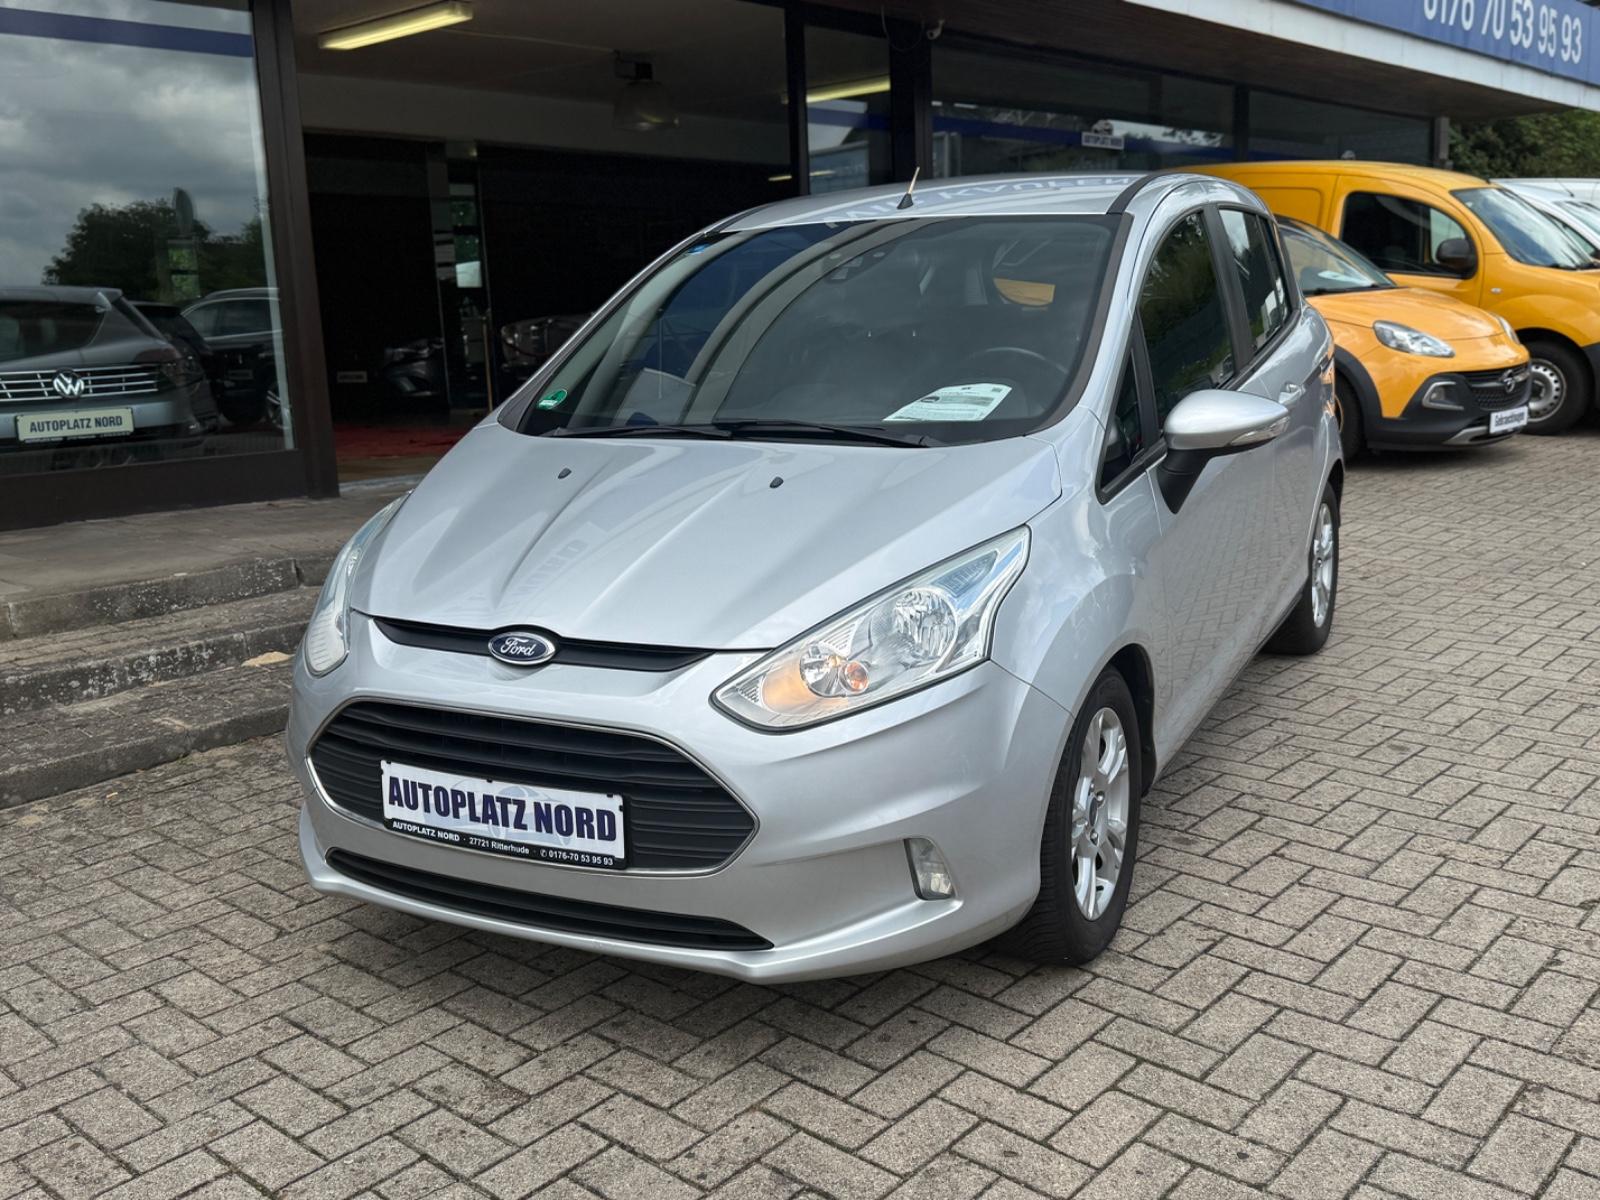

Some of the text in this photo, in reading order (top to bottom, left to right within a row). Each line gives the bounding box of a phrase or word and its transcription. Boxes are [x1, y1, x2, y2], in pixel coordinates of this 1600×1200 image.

[1481, 0, 1506, 40] 70
[1509, 0, 1535, 49] 53
[1538, 5, 1557, 58] 95
[1561, 14, 1582, 64] 93
[29, 415, 123, 433] AUTOPLATZ NORD
[501, 637, 537, 656] Ford
[388, 775, 617, 842] AUTOPLATZ NORD
[392, 821, 614, 866] AUTOPLATZ NORD 27721 Ritterhude 0176-70 53 95 93
